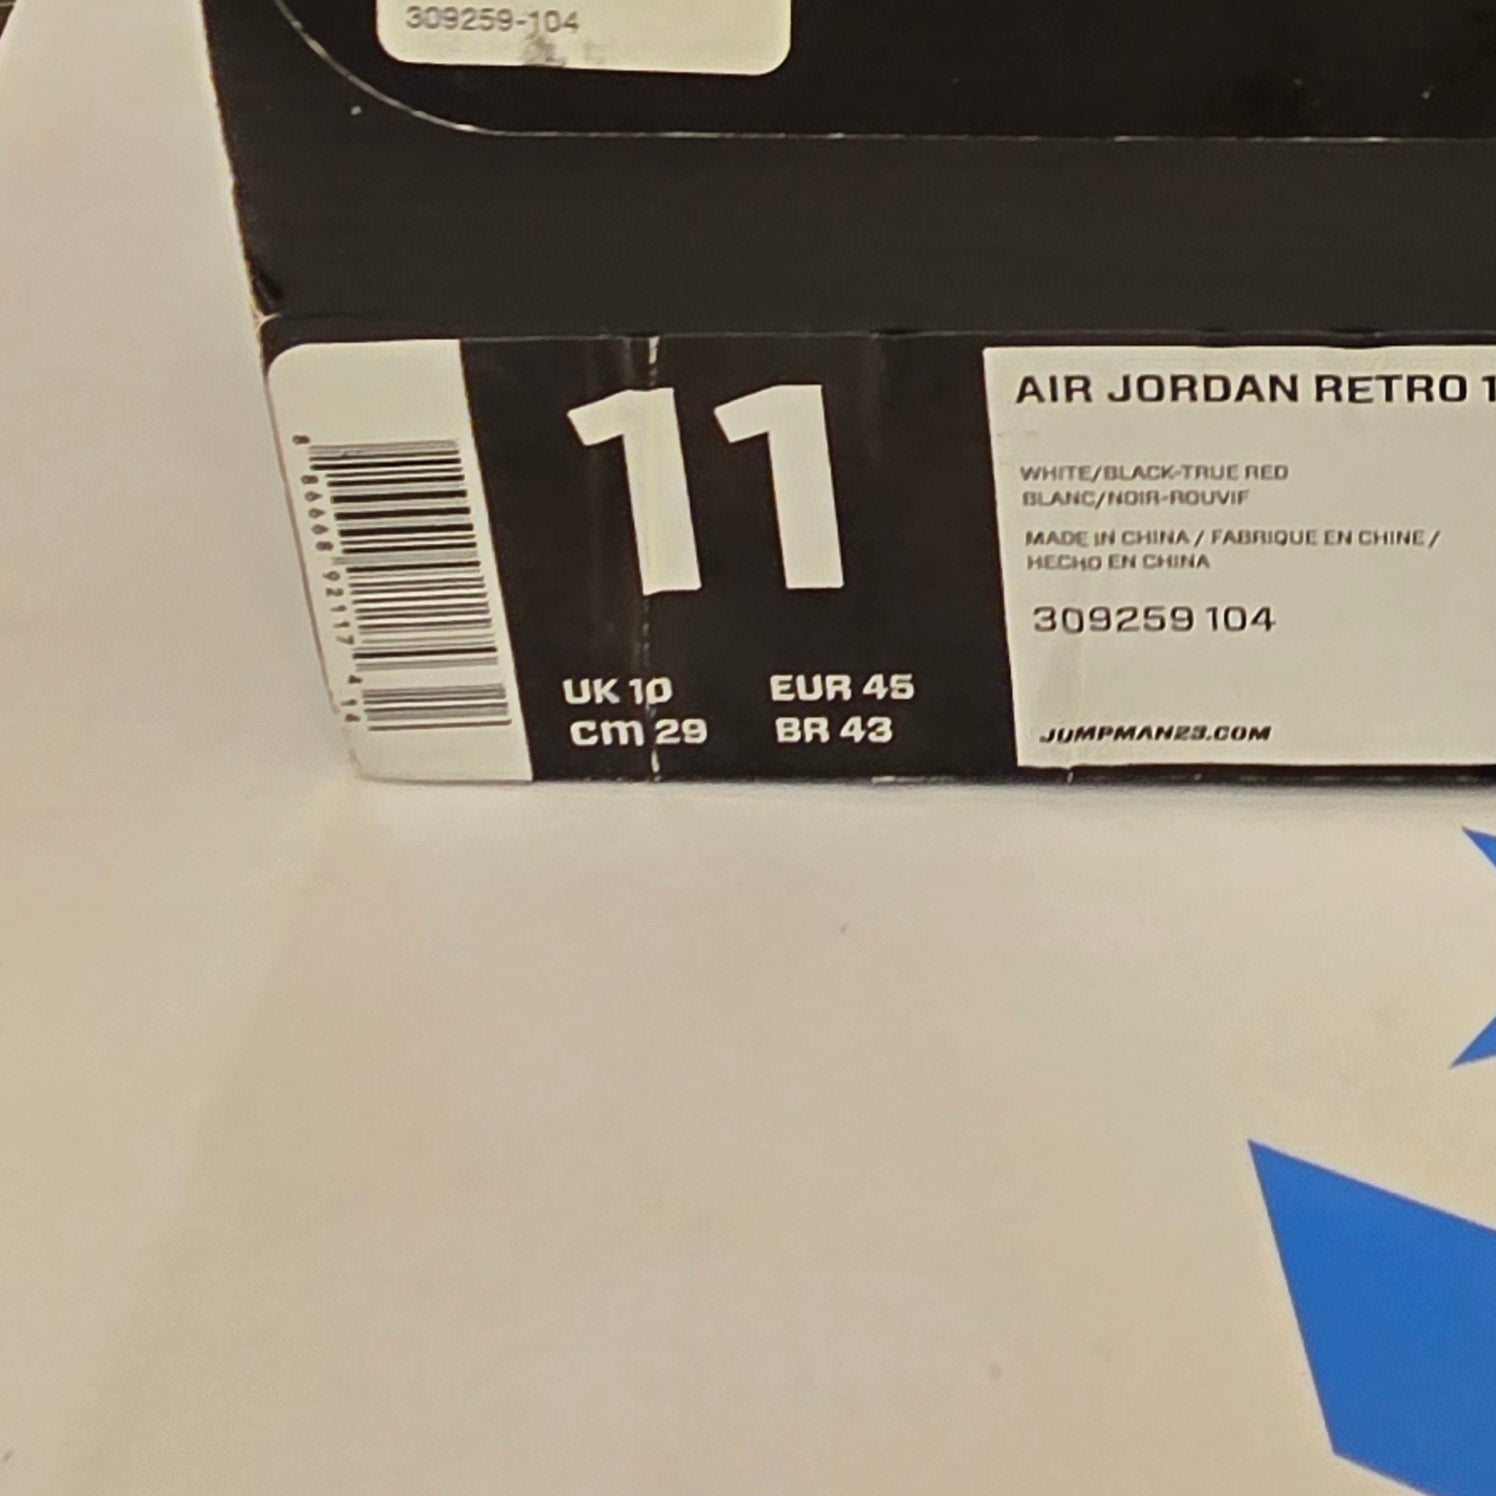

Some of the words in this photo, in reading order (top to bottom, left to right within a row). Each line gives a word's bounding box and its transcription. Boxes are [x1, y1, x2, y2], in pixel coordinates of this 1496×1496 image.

[406, 6, 579, 33] 309259-104
[1015, 374, 1092, 404] AIR
[1107, 374, 1299, 404] JORDAN
[1314, 374, 1467, 404] RETRO
[1020, 464, 1239, 482] WHITE/BLACK-TRUE
[1244, 464, 1289, 481] RED
[567, 384, 844, 596] 11
[1022, 489, 1250, 509] BLANC/NOIR-ROUVIF
[1025, 530, 1089, 548] MADE
[1094, 530, 1115, 546] IN
[1121, 530, 1189, 546] CHINA
[1211, 530, 1319, 547] FABRIQUE
[1324, 530, 1352, 546] EN
[1027, 555, 1102, 572] HECHO
[1108, 554, 1136, 570] EN
[1142, 554, 1210, 570] CHINA
[1033, 606, 1194, 634] 309259
[1205, 606, 1277, 633] 104
[562, 678, 620, 705] UK
[629, 677, 673, 705] 10
[770, 674, 852, 702] EUR
[862, 674, 915, 700] 45
[655, 718, 708, 745] 29
[775, 717, 830, 743] BR
[840, 716, 893, 744] 43
[1039, 724, 1272, 744] JUMPMAN23.COM
